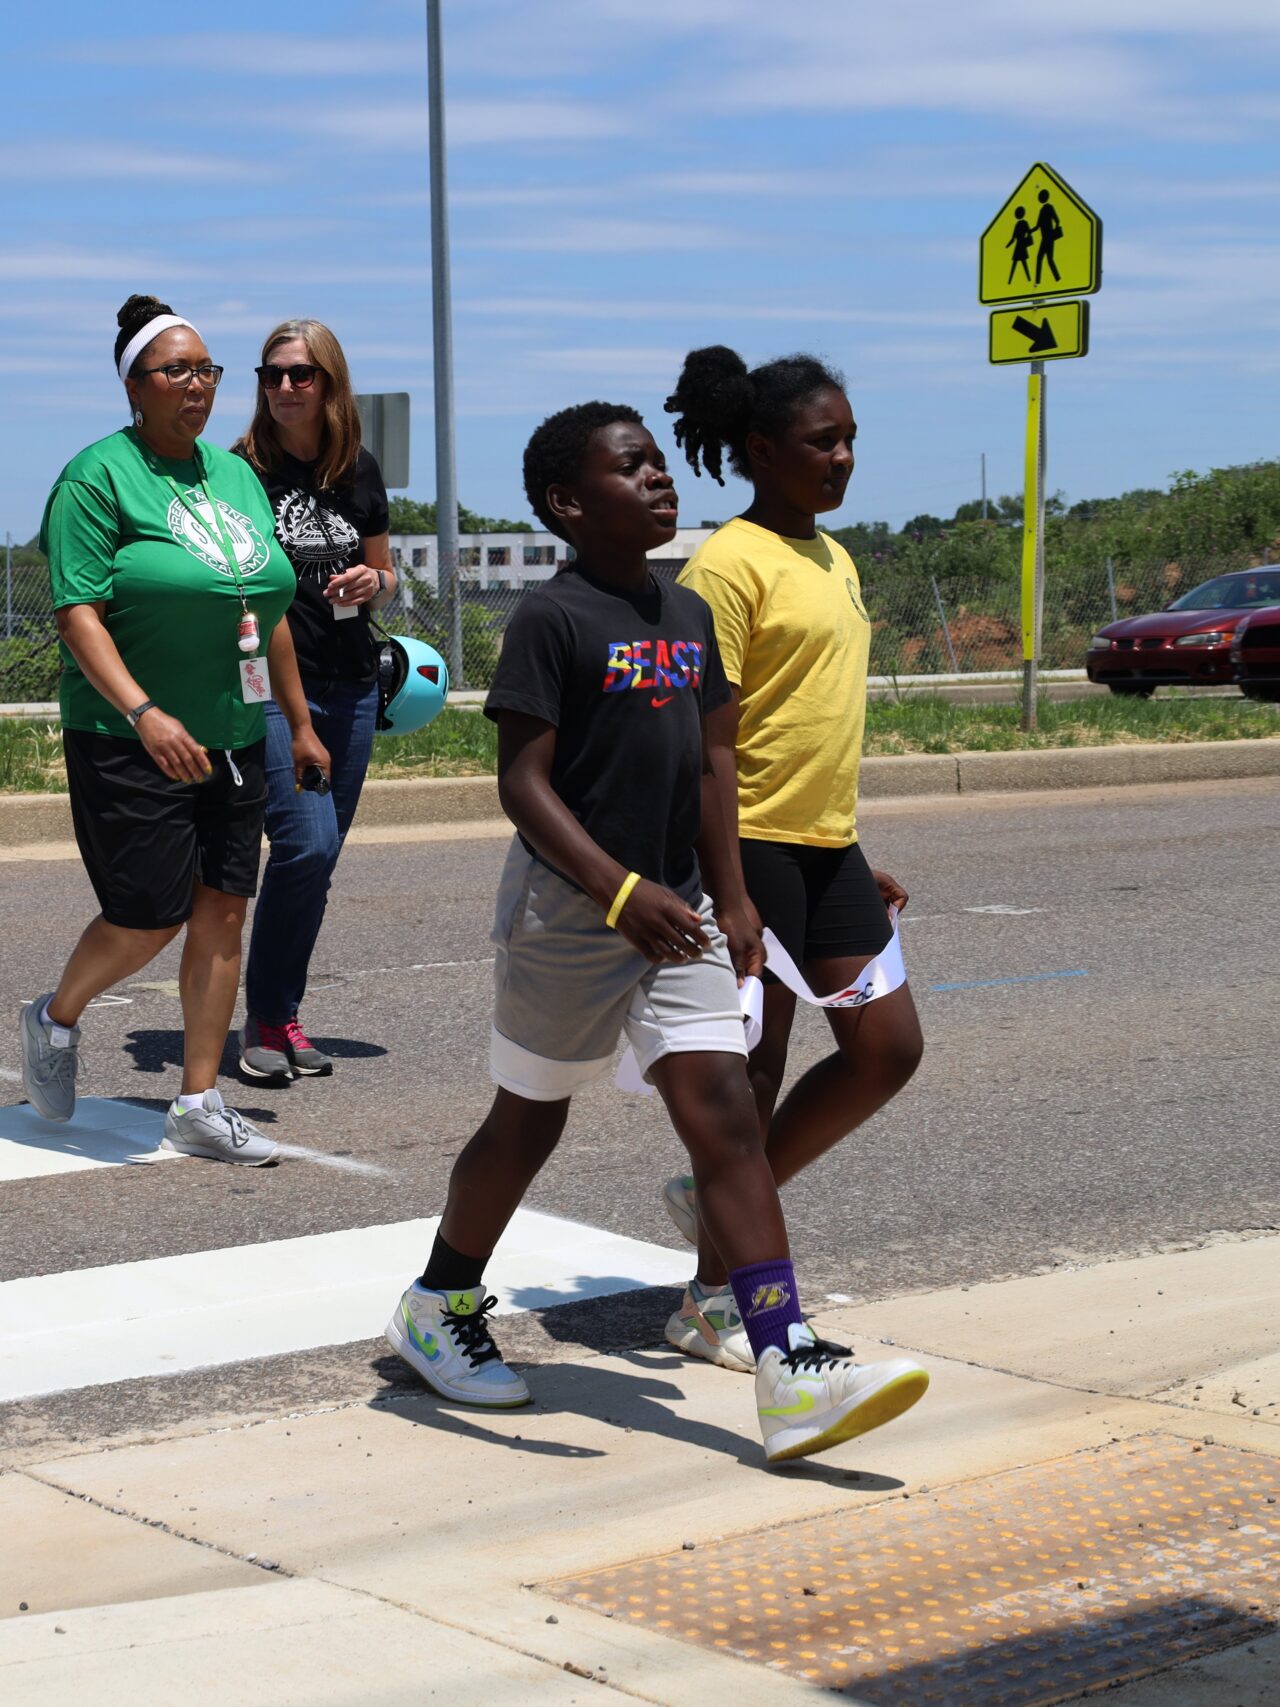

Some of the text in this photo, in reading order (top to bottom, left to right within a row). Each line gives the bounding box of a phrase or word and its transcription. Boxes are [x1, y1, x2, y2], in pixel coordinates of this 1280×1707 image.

[170, 495, 193, 535] GREE
[194, 492, 258, 535] MGNET
[601, 639, 704, 693] BEAST
